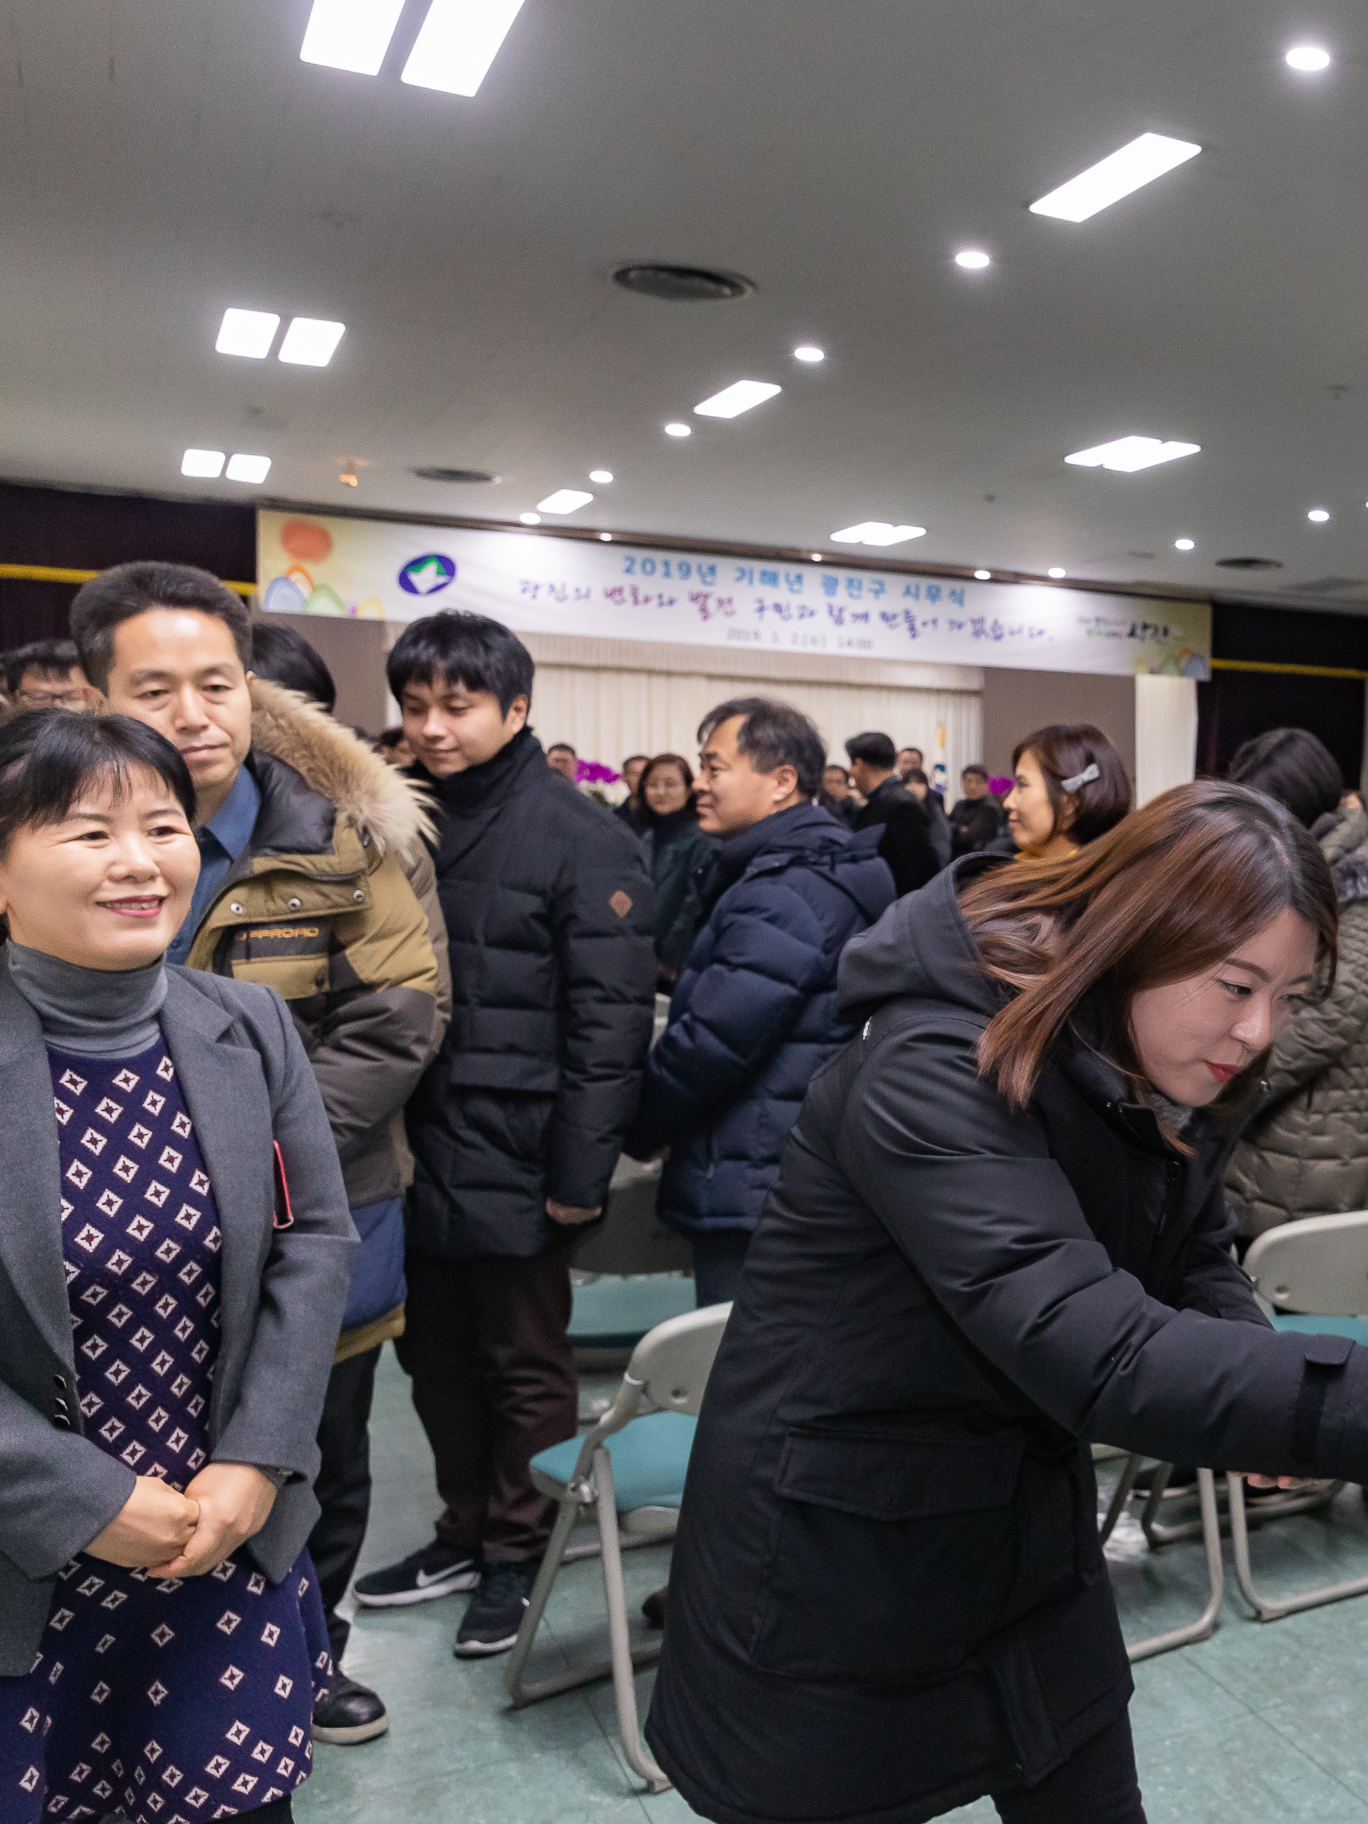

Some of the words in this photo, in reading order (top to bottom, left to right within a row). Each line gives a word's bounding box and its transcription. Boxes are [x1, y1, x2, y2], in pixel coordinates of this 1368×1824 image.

[624, 555, 717, 586] 2019년
[734, 565, 803, 595] 기해년
[821, 573, 886, 600] 광진구
[903, 583, 965, 607] 시무식
